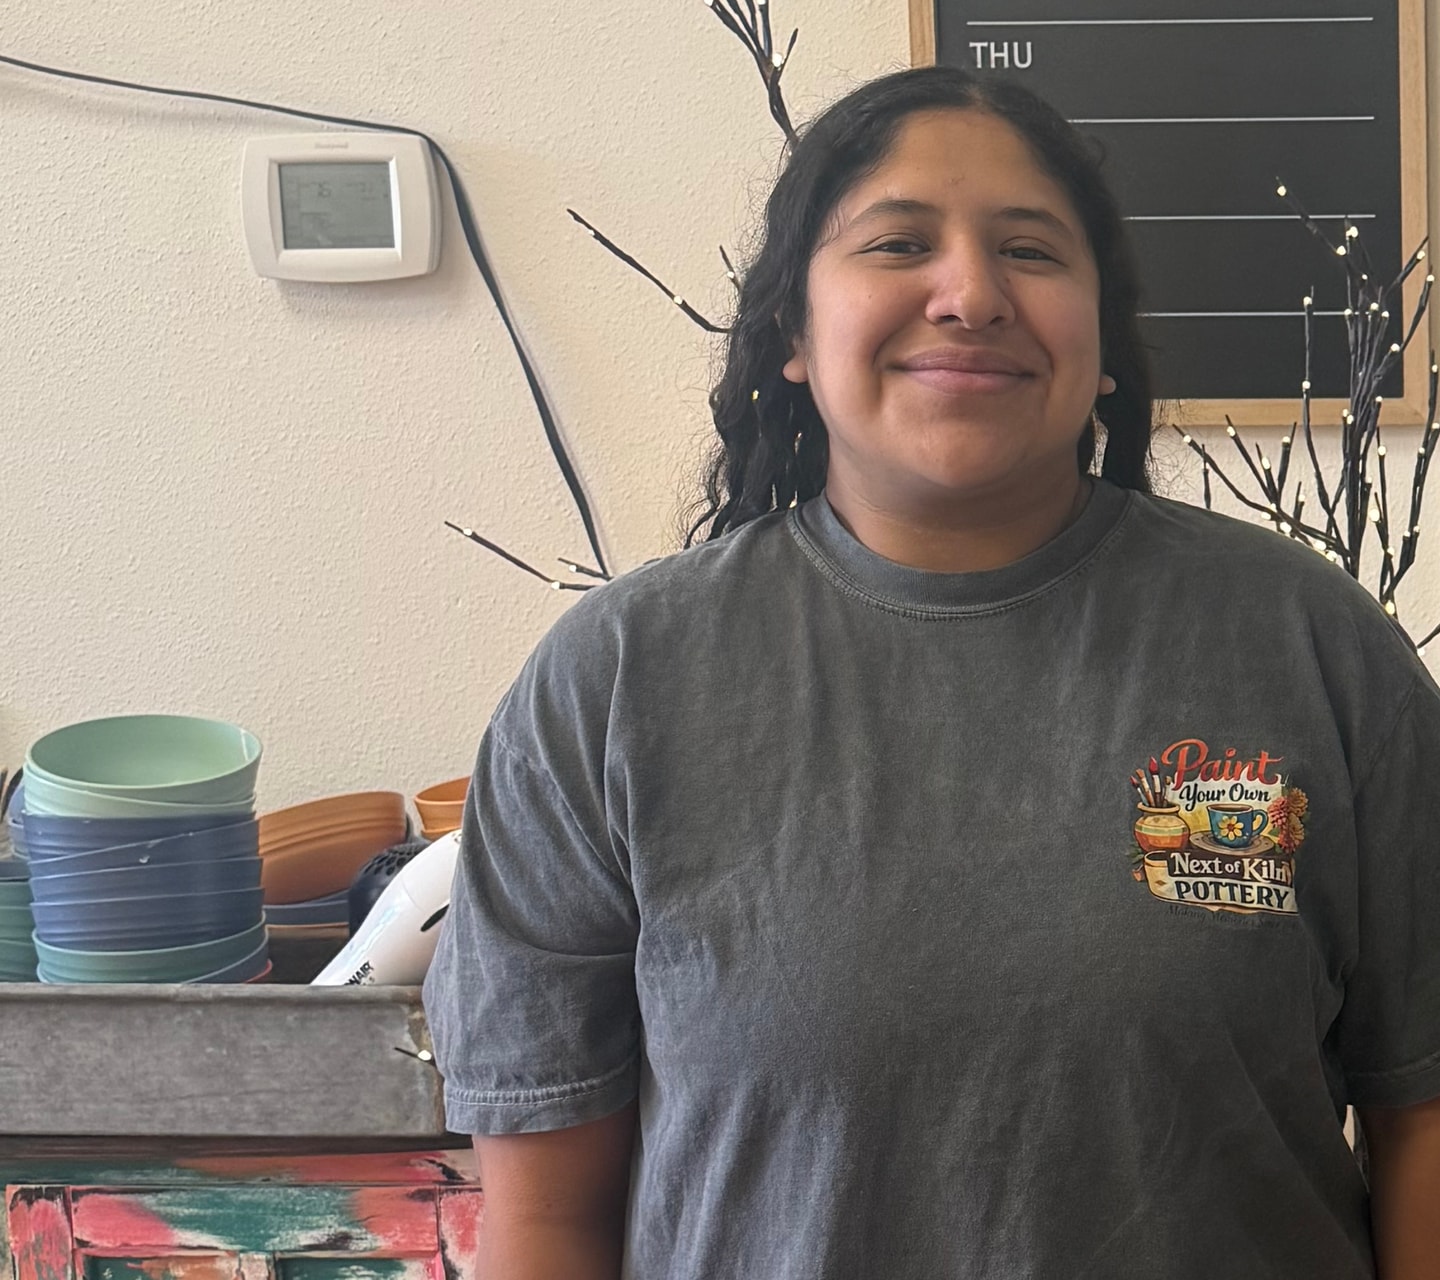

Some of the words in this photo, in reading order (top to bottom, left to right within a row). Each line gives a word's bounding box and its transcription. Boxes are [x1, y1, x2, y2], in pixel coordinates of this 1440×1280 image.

[969, 41, 1032, 69] THU
[1161, 738, 1284, 791] Paint
[1179, 783, 1225, 812] Your
[1228, 782, 1271, 802] Own
[1170, 852, 1222, 875] Next
[1224, 860, 1241, 873] of
[1241, 858, 1287, 884] Kiln
[1174, 881, 1290, 909] POTTERY
[344, 960, 374, 985] NAIR
